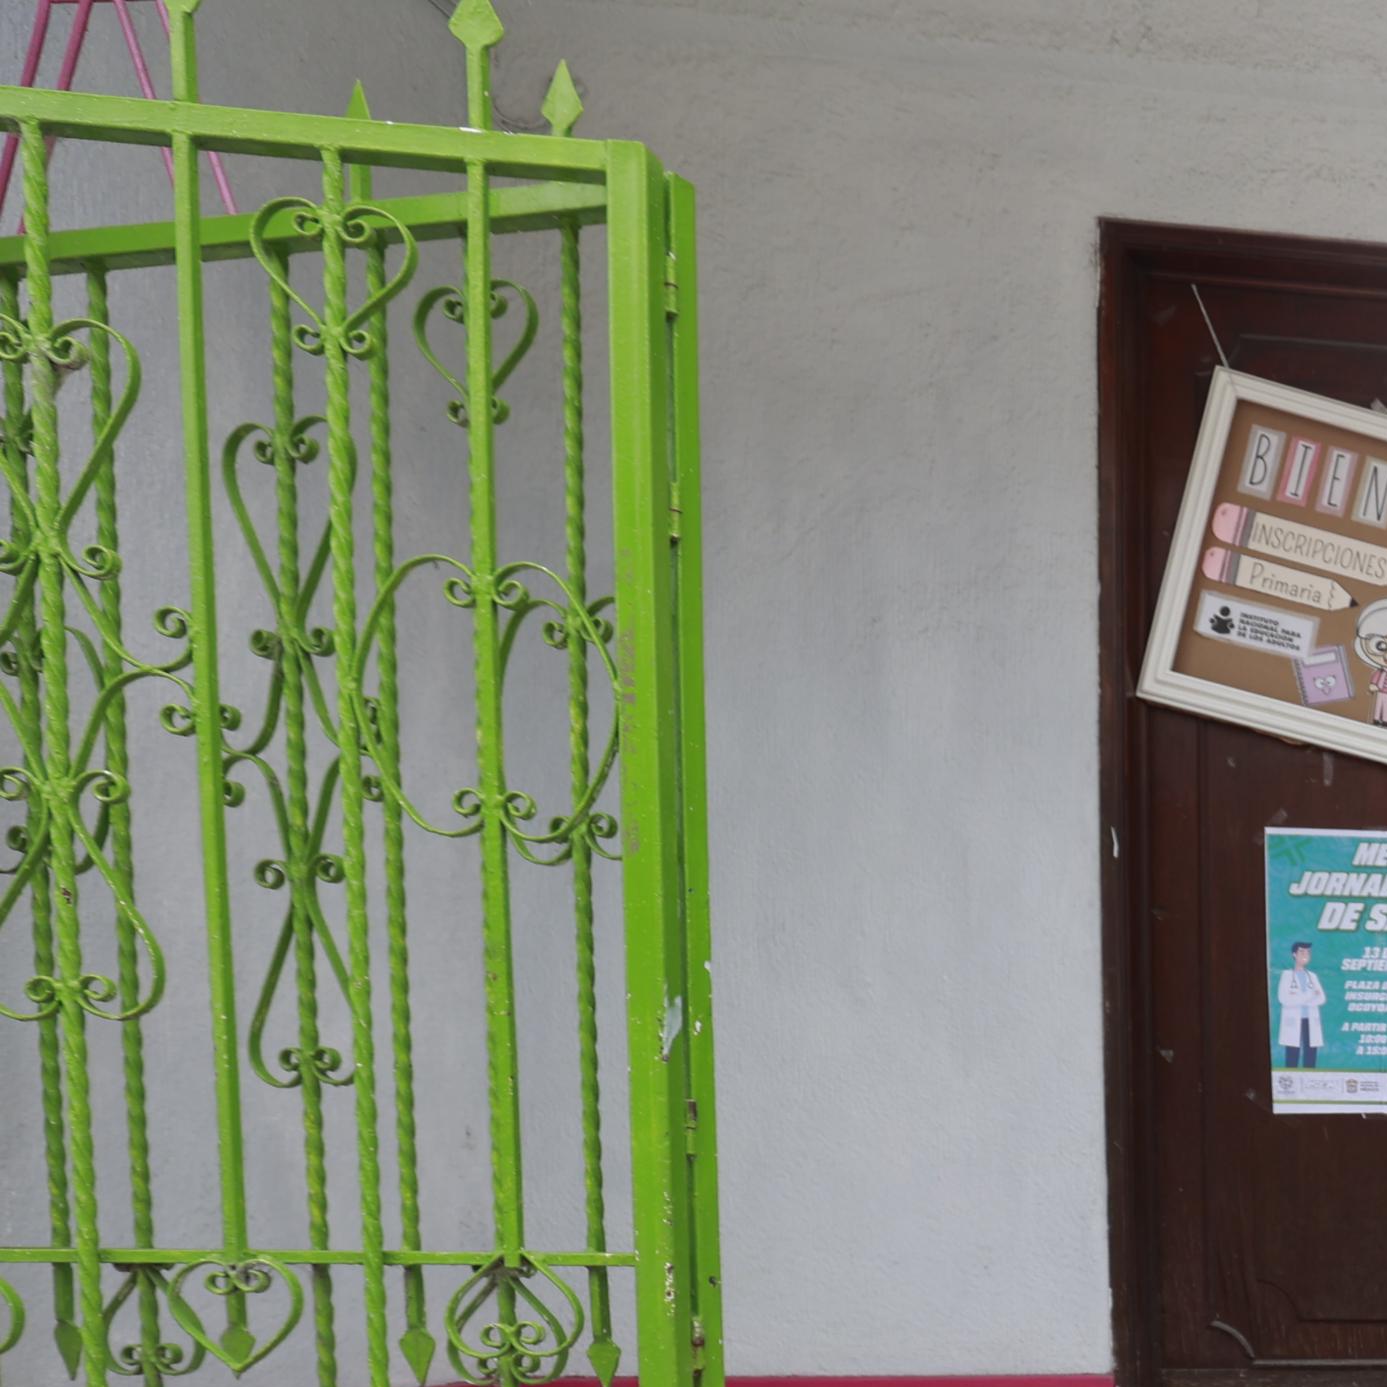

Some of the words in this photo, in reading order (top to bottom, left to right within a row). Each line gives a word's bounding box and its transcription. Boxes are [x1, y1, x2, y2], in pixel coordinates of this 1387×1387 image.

[1251, 521, 1387, 580] INSCRIPCIONES
[1250, 562, 1323, 604] Primaria
[1317, 901, 1365, 931] DE
[1362, 946, 1381, 960] 13
[1344, 980, 1380, 990] PLAZA
[1341, 1022, 1350, 1032] A
[1351, 1022, 1387, 1032] PARTIR
